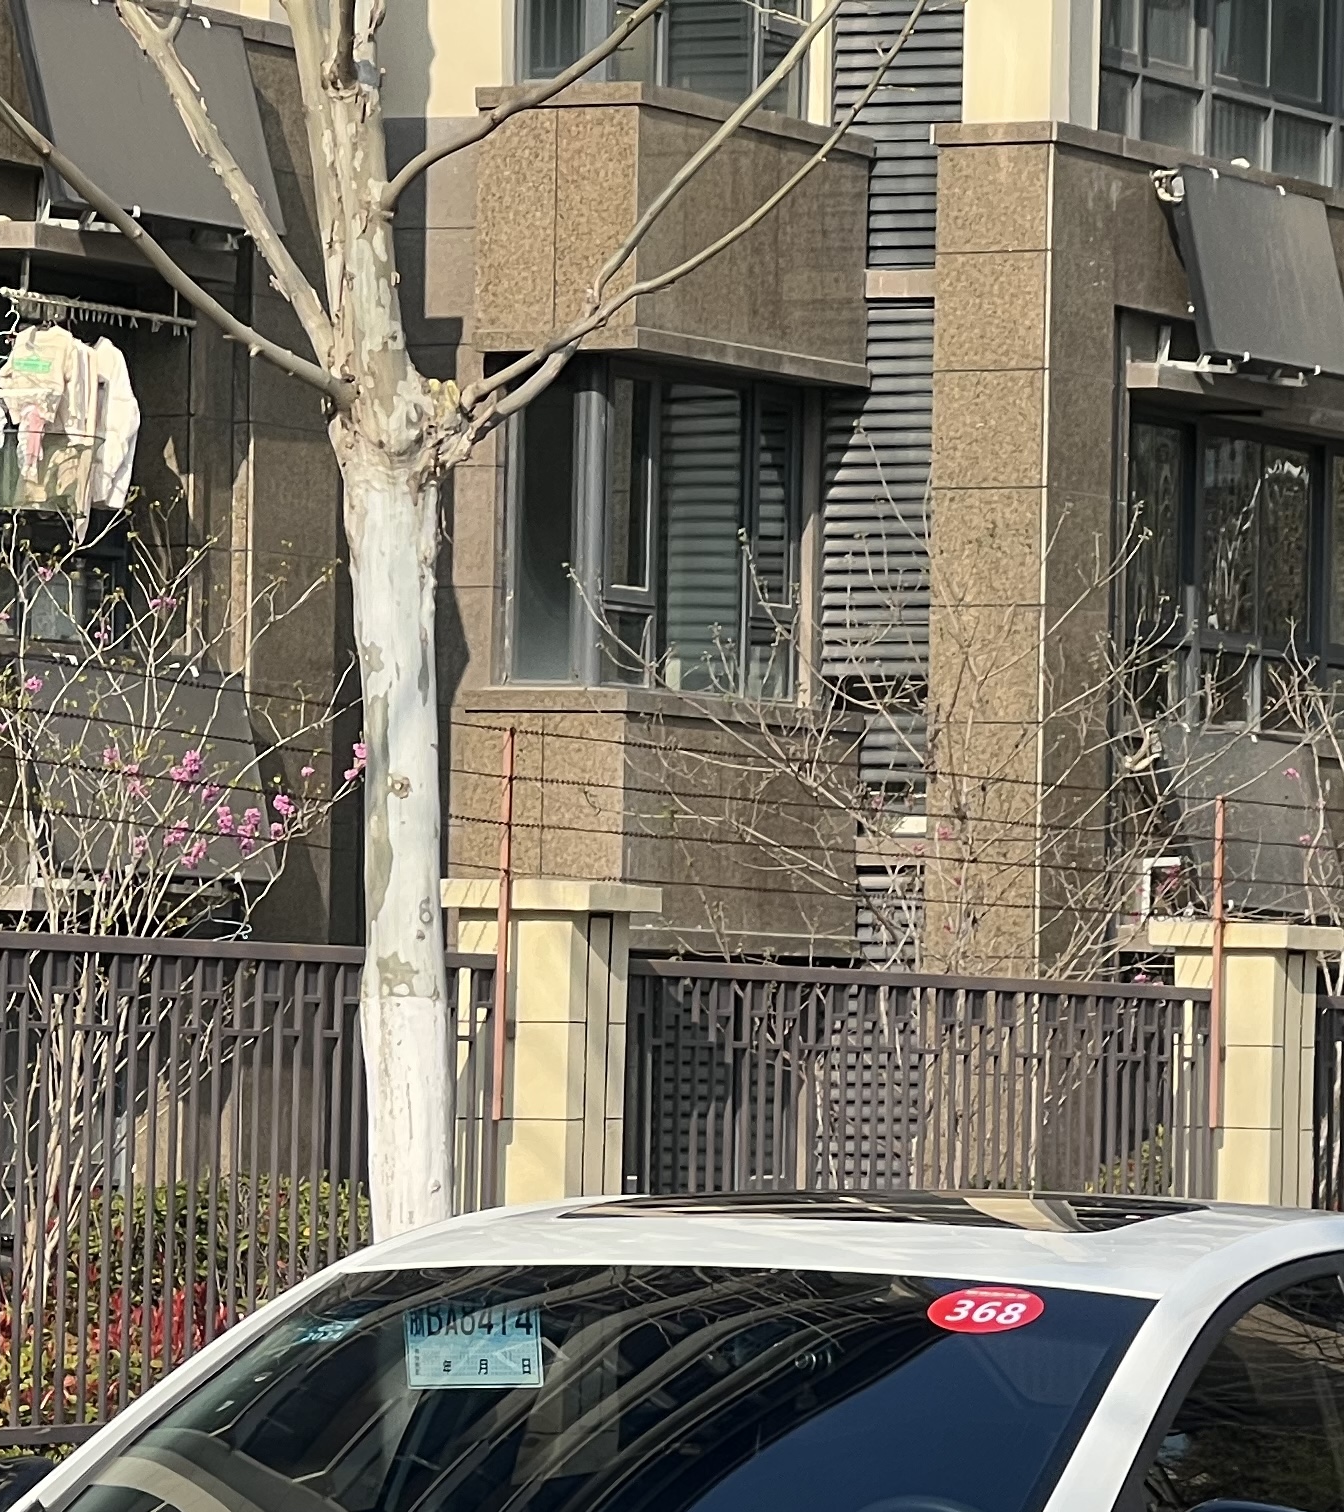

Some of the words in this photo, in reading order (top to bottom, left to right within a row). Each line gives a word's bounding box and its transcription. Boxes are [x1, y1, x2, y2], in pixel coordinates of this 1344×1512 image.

[944, 1299, 1027, 1325] 368
[477, 1358, 489, 1376] 月
[521, 1358, 532, 1375] 日
